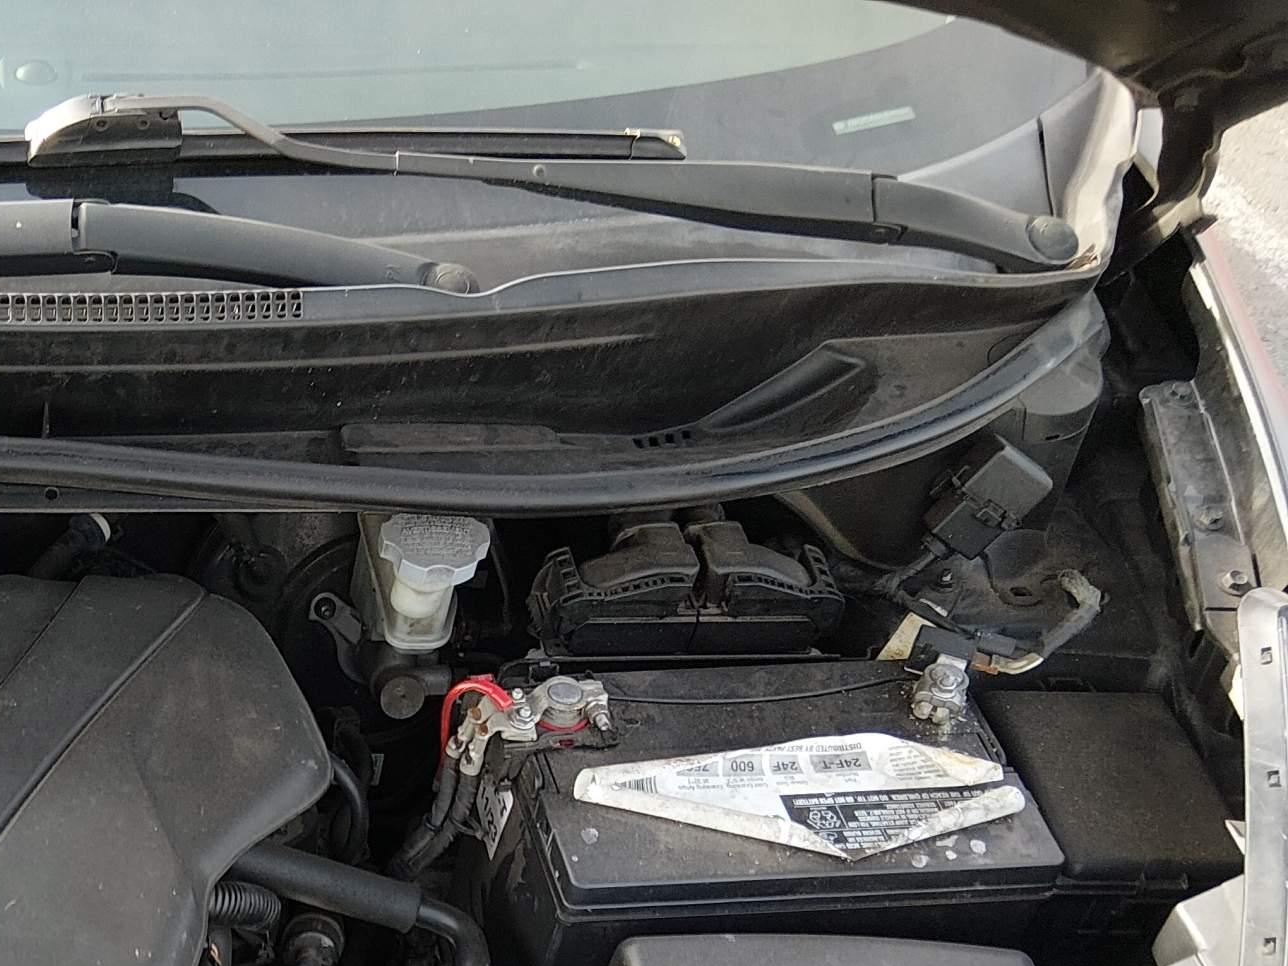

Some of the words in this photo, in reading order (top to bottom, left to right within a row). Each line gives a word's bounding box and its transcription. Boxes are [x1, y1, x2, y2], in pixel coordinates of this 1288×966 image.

[730, 760, 755, 773] 600
[773, 760, 798, 770] 24F
[821, 758, 861, 770] 24F-T
